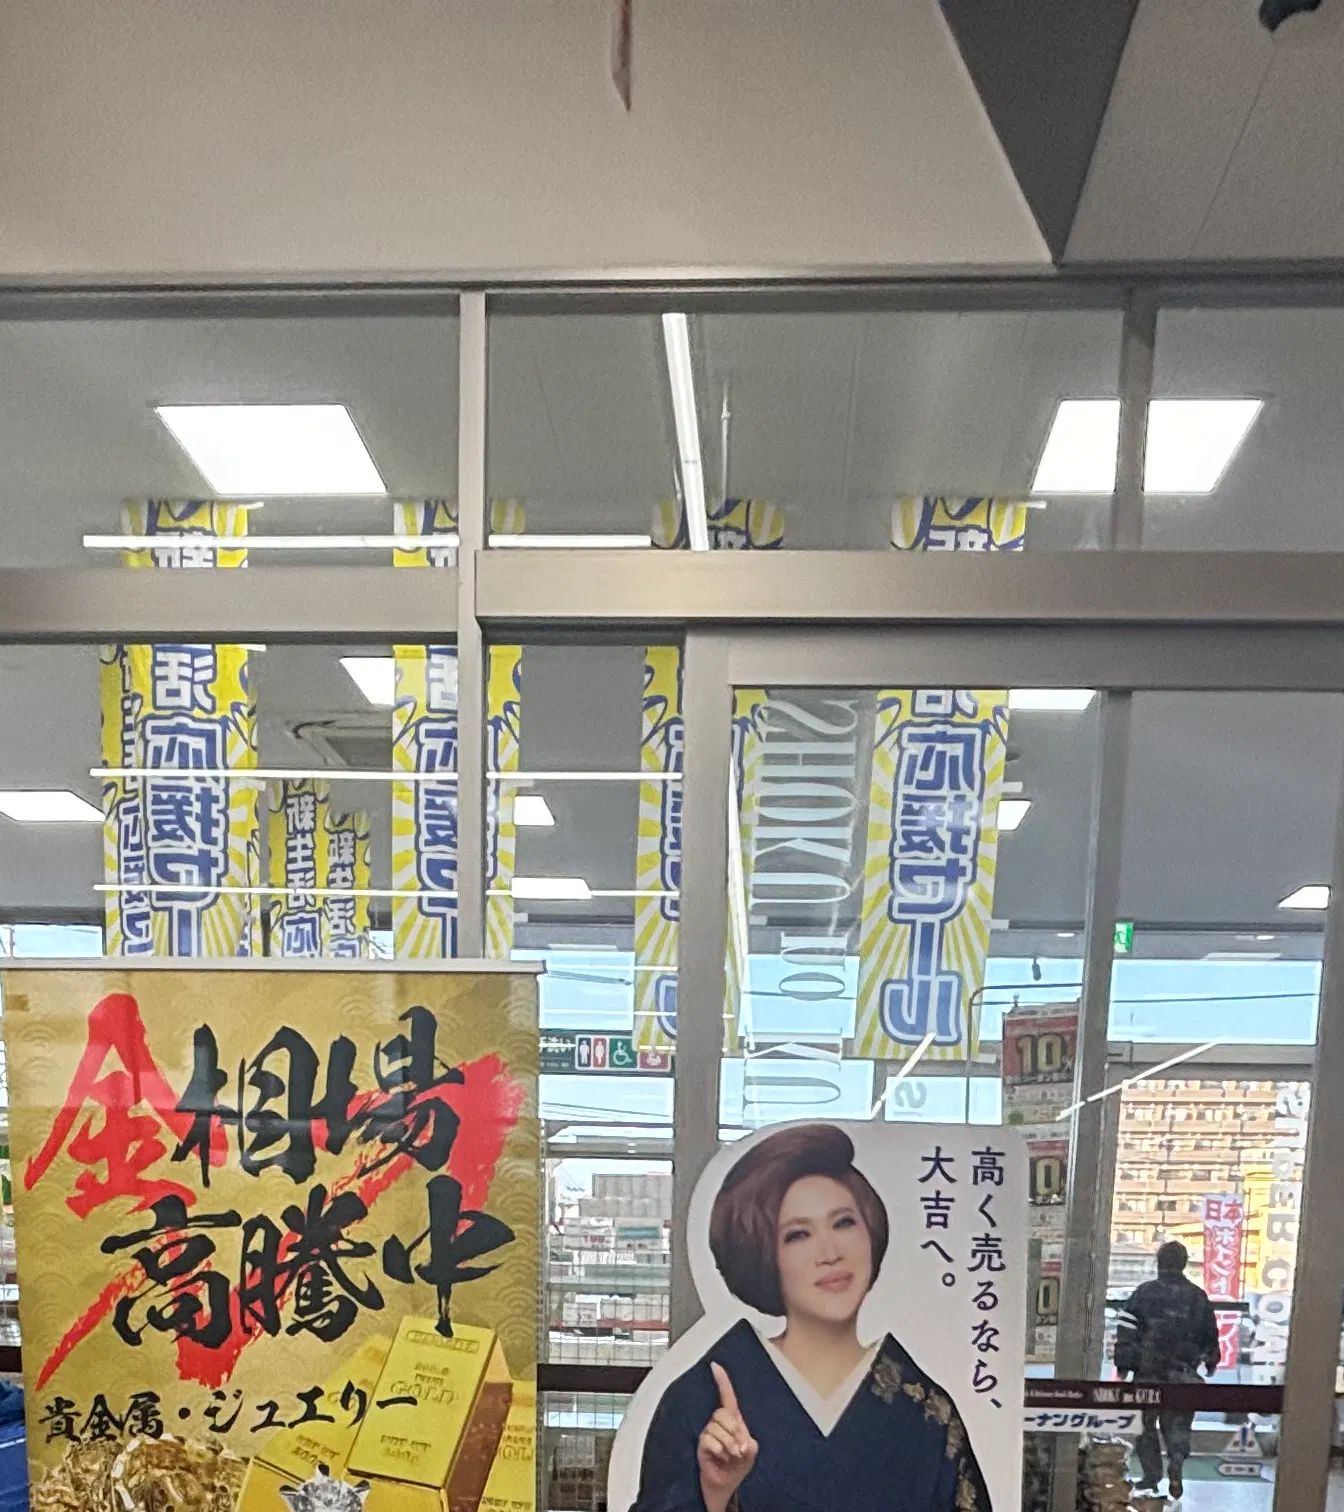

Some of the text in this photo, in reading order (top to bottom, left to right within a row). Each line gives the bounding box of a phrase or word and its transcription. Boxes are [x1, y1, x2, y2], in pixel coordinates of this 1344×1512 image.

[25, 993, 464, 1219] 金相場
[101, 1175, 516, 1350] 高騰中
[918, 1146, 956, 1287] 大吉へ。
[967, 1146, 1006, 1408] 高く売るなら、
[38, 1381, 418, 1445] 貴金属・ジュエリー
